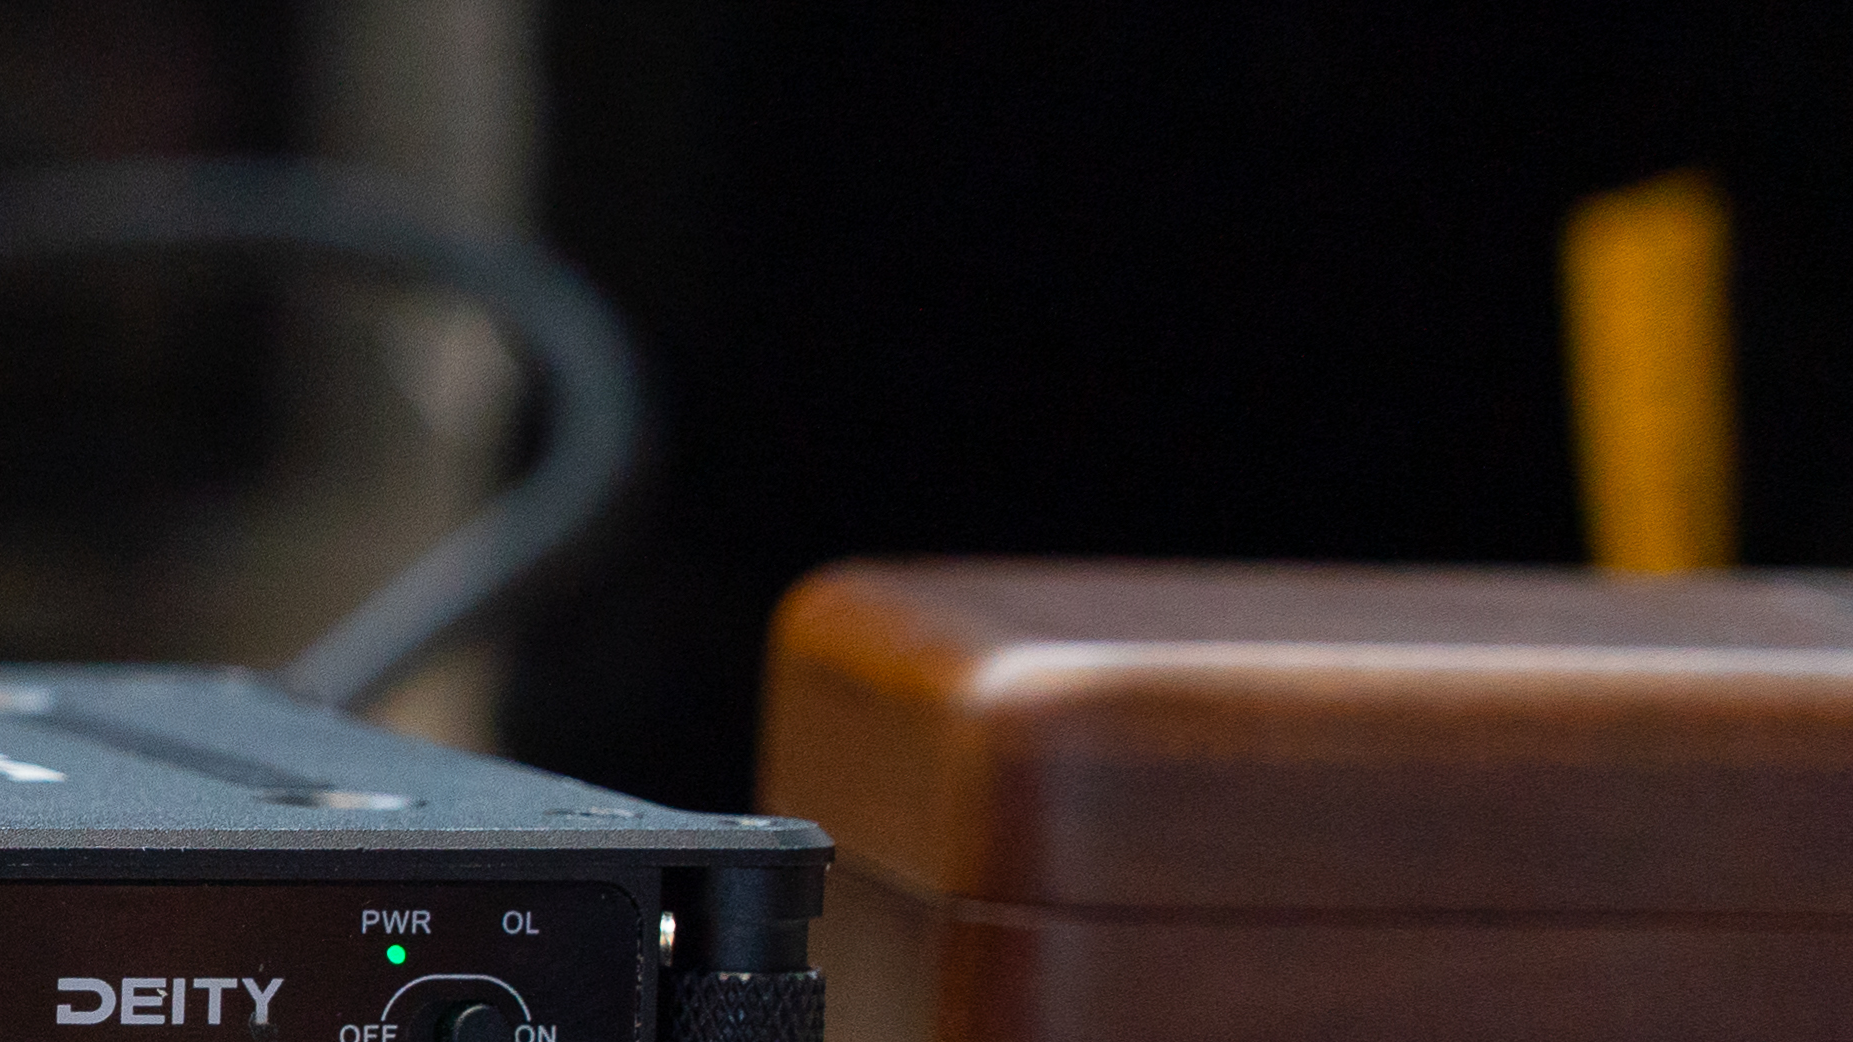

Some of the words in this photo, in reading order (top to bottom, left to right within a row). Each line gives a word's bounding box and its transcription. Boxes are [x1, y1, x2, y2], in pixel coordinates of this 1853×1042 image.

[361, 909, 431, 935] PWR
[502, 910, 540, 935] OL
[56, 977, 285, 1025] DEITY
